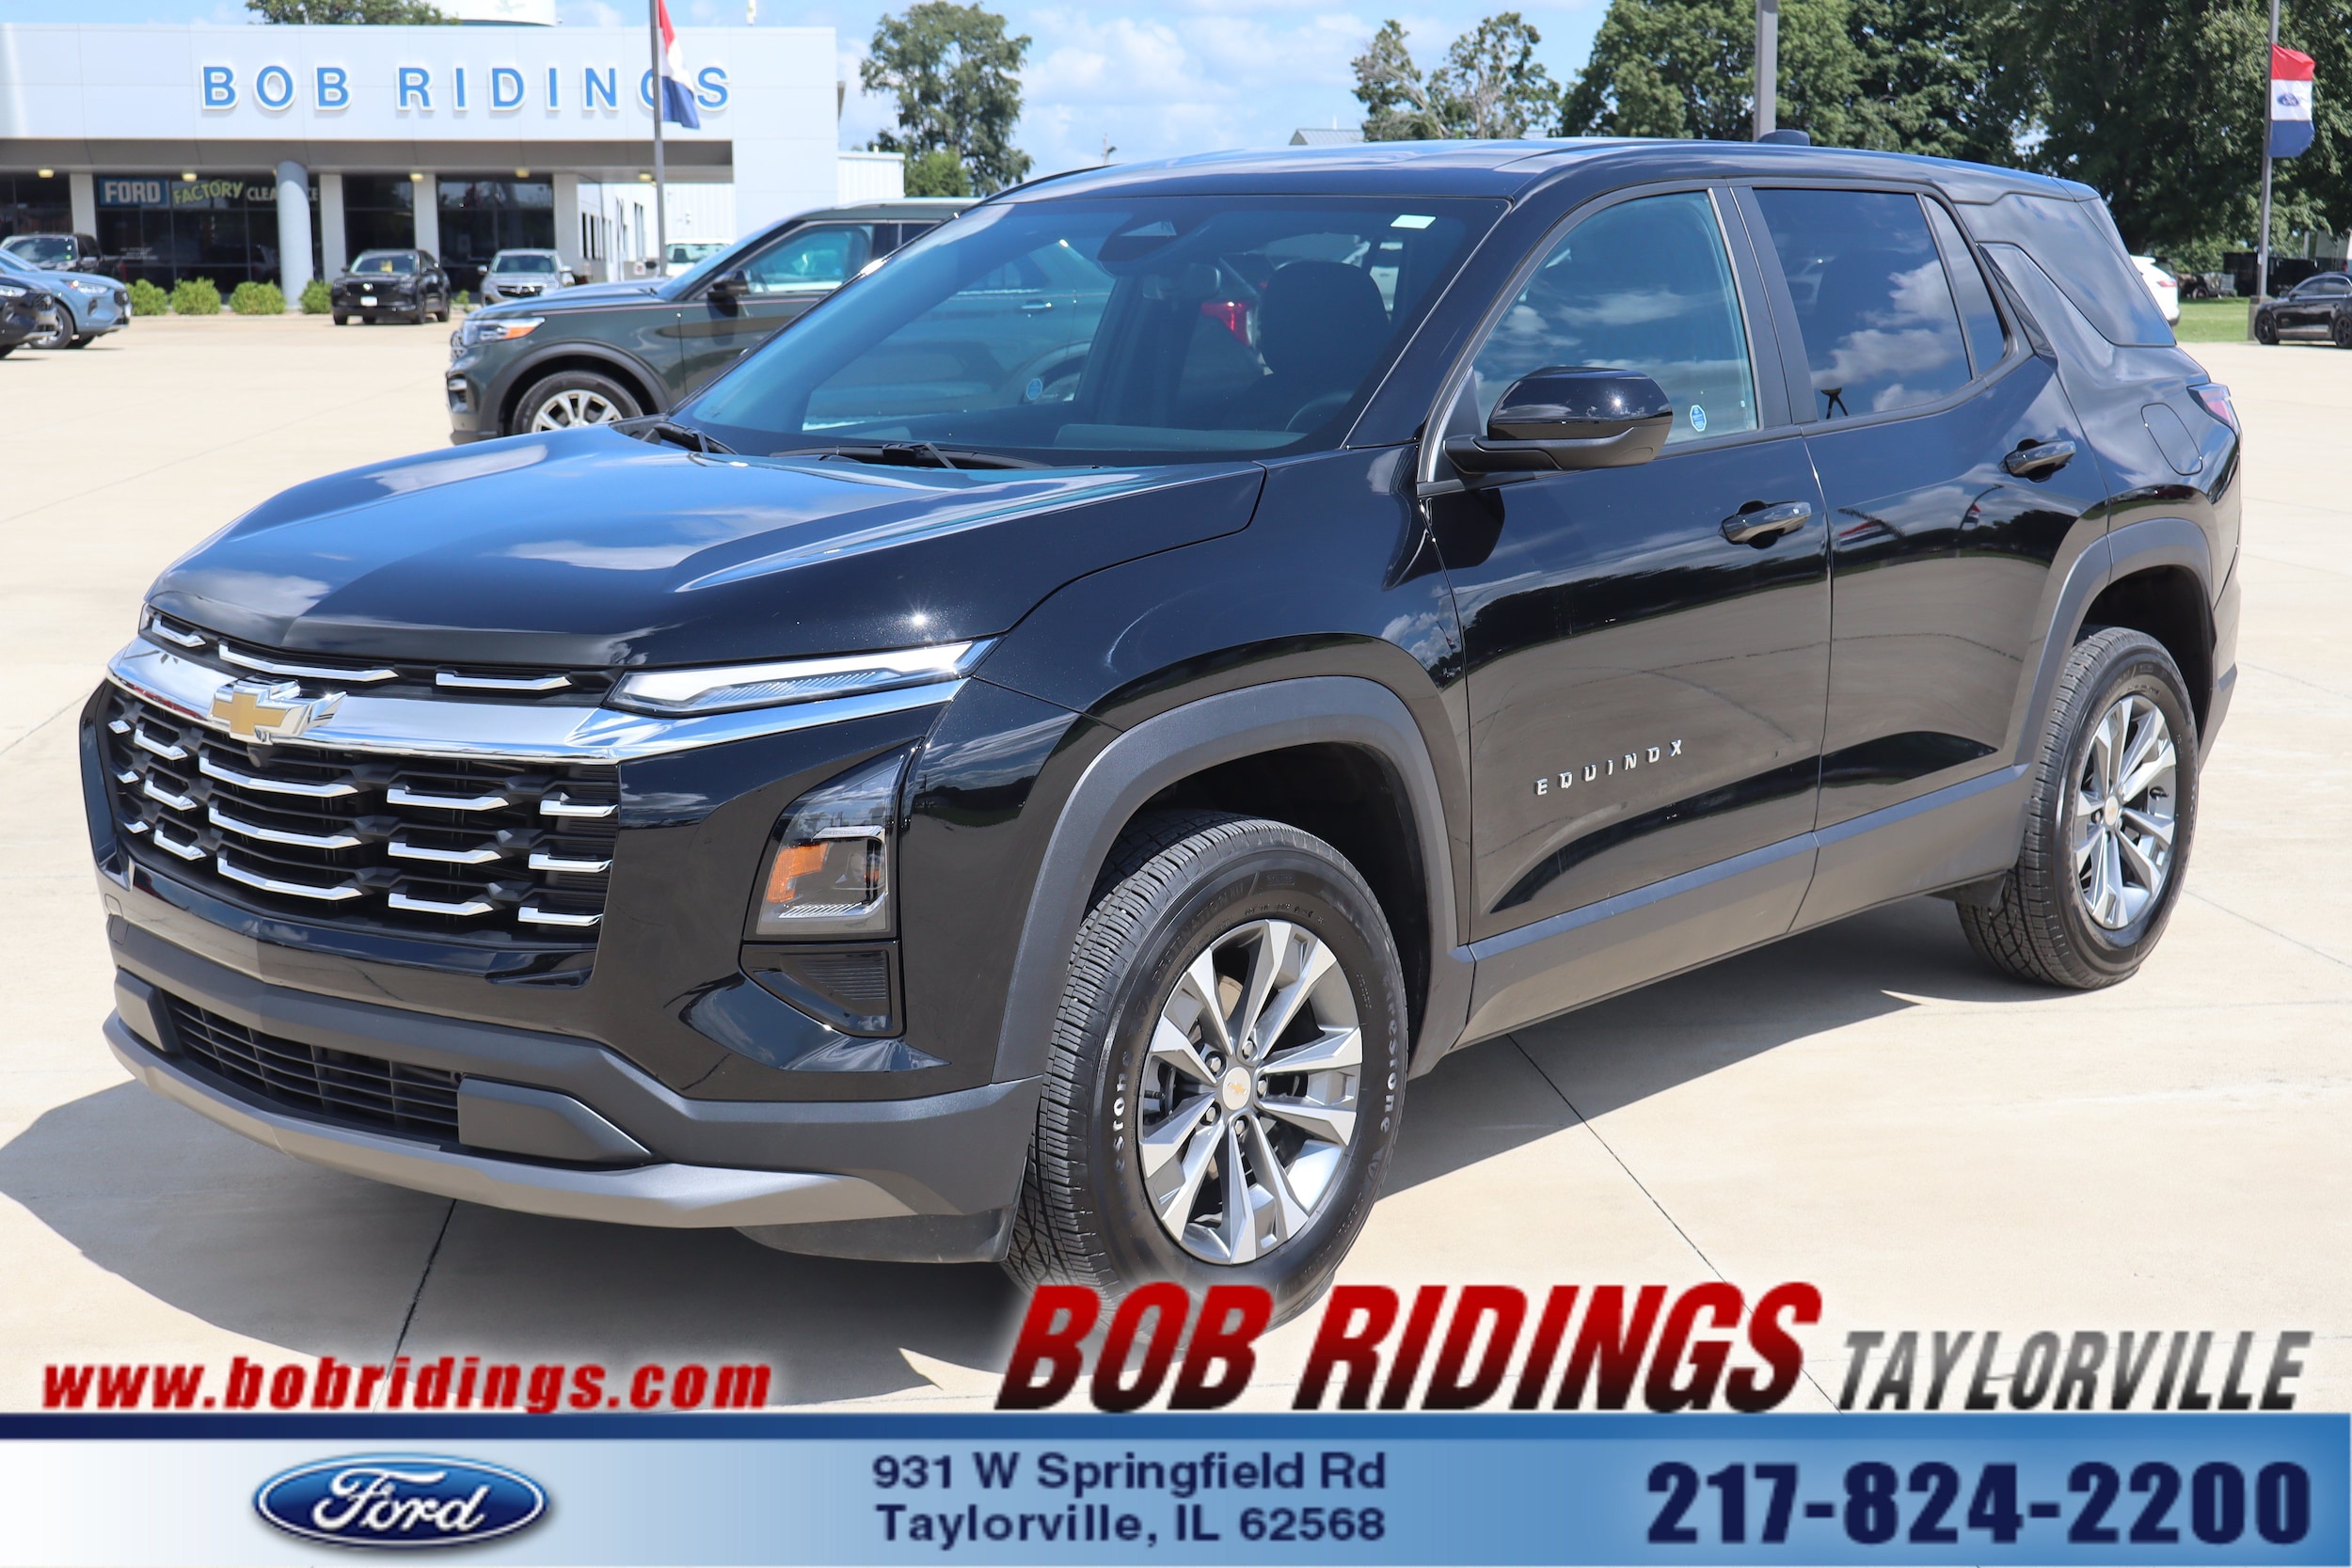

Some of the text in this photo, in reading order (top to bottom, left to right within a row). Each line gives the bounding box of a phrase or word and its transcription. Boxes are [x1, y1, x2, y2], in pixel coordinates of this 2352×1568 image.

[201, 64, 351, 110] BOB
[104, 181, 161, 203] FORD
[172, 181, 244, 204] FACTORY
[1535, 738, 1683, 796] EQUINOX
